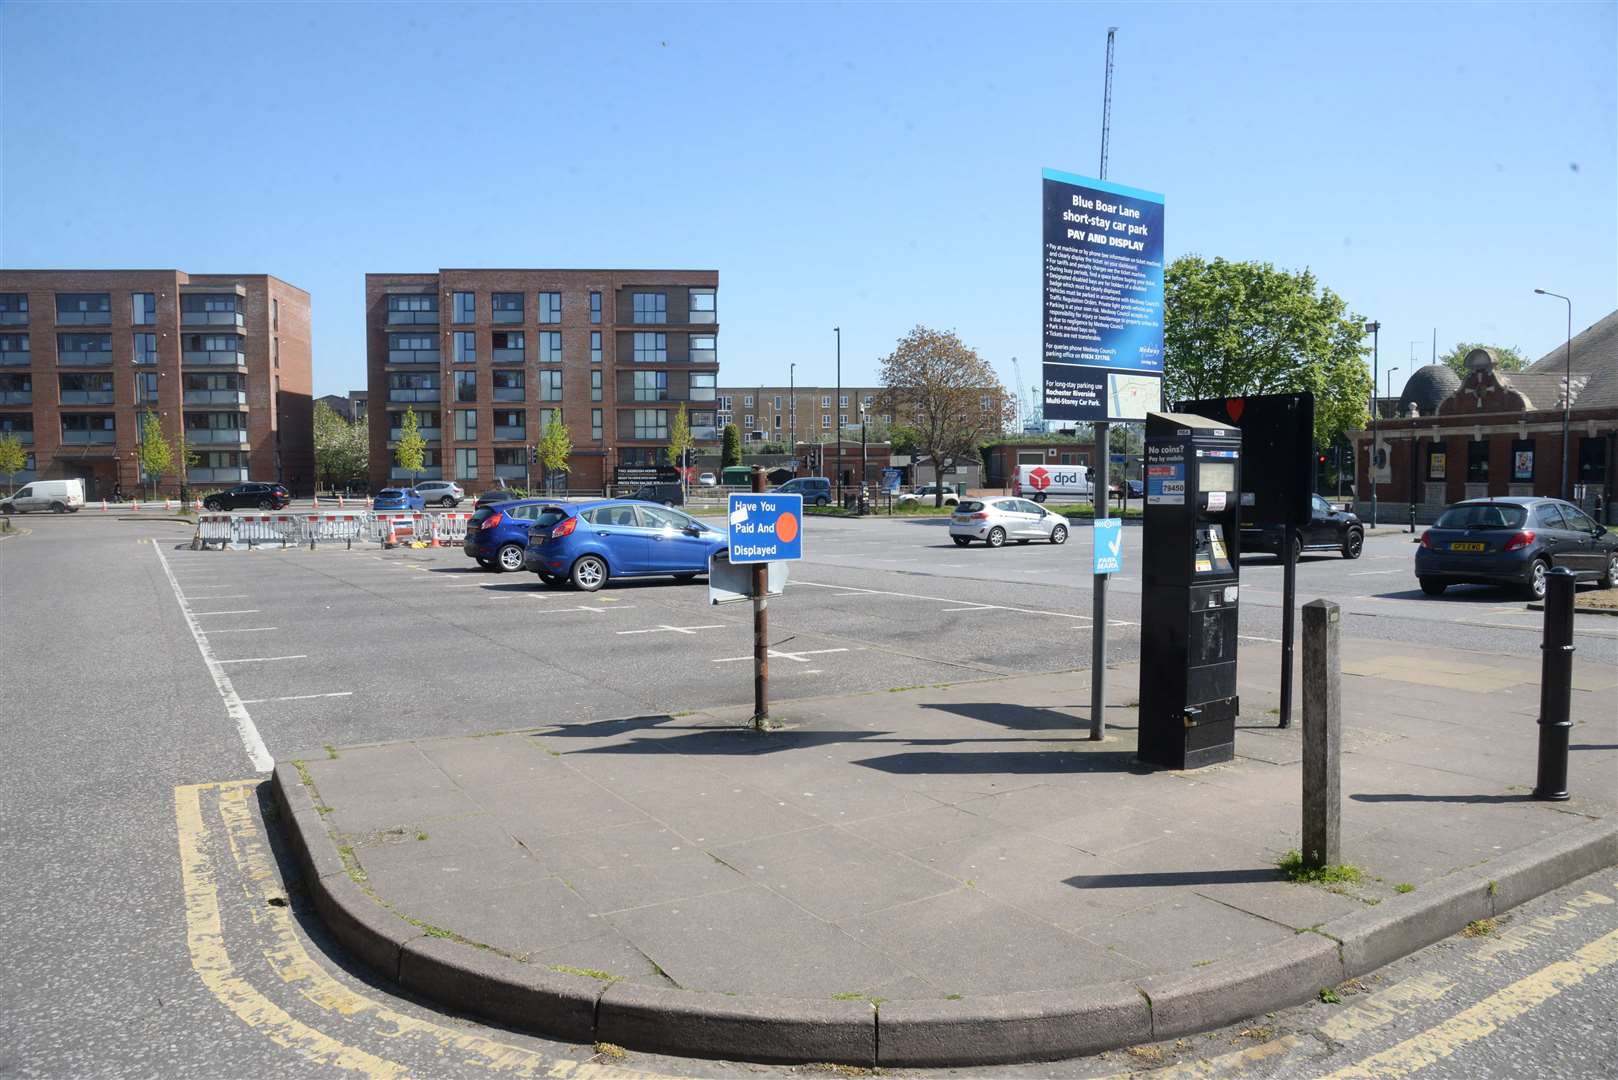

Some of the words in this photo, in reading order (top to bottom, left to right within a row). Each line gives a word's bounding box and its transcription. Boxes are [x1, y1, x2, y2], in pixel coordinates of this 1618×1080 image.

[1072, 195, 1093, 209] Blue
[1096, 200, 1117, 214] Boar
[1119, 204, 1140, 218] Lane
[1063, 210, 1110, 230] short-stay
[1112, 221, 1126, 231] car
[1128, 224, 1148, 236] park
[1068, 229, 1085, 240] PAY
[1088, 233, 1107, 245] AND
[1109, 236, 1144, 251] DISPLAY
[1058, 252, 1070, 260] clearly
[1071, 254, 1084, 262] display
[1049, 310, 1075, 318] responsibility
[1055, 381, 1075, 389] long-stay
[1077, 382, 1094, 390] parking
[1046, 397, 1078, 406] Multi-Storey
[1161, 445, 1184, 454] coins?
[1054, 472, 1076, 486] dpd
[735, 501, 757, 511] Have
[760, 501, 776, 511] You
[736, 523, 754, 533] Paid
[758, 523, 775, 533] And
[734, 545, 776, 557] Displayed
